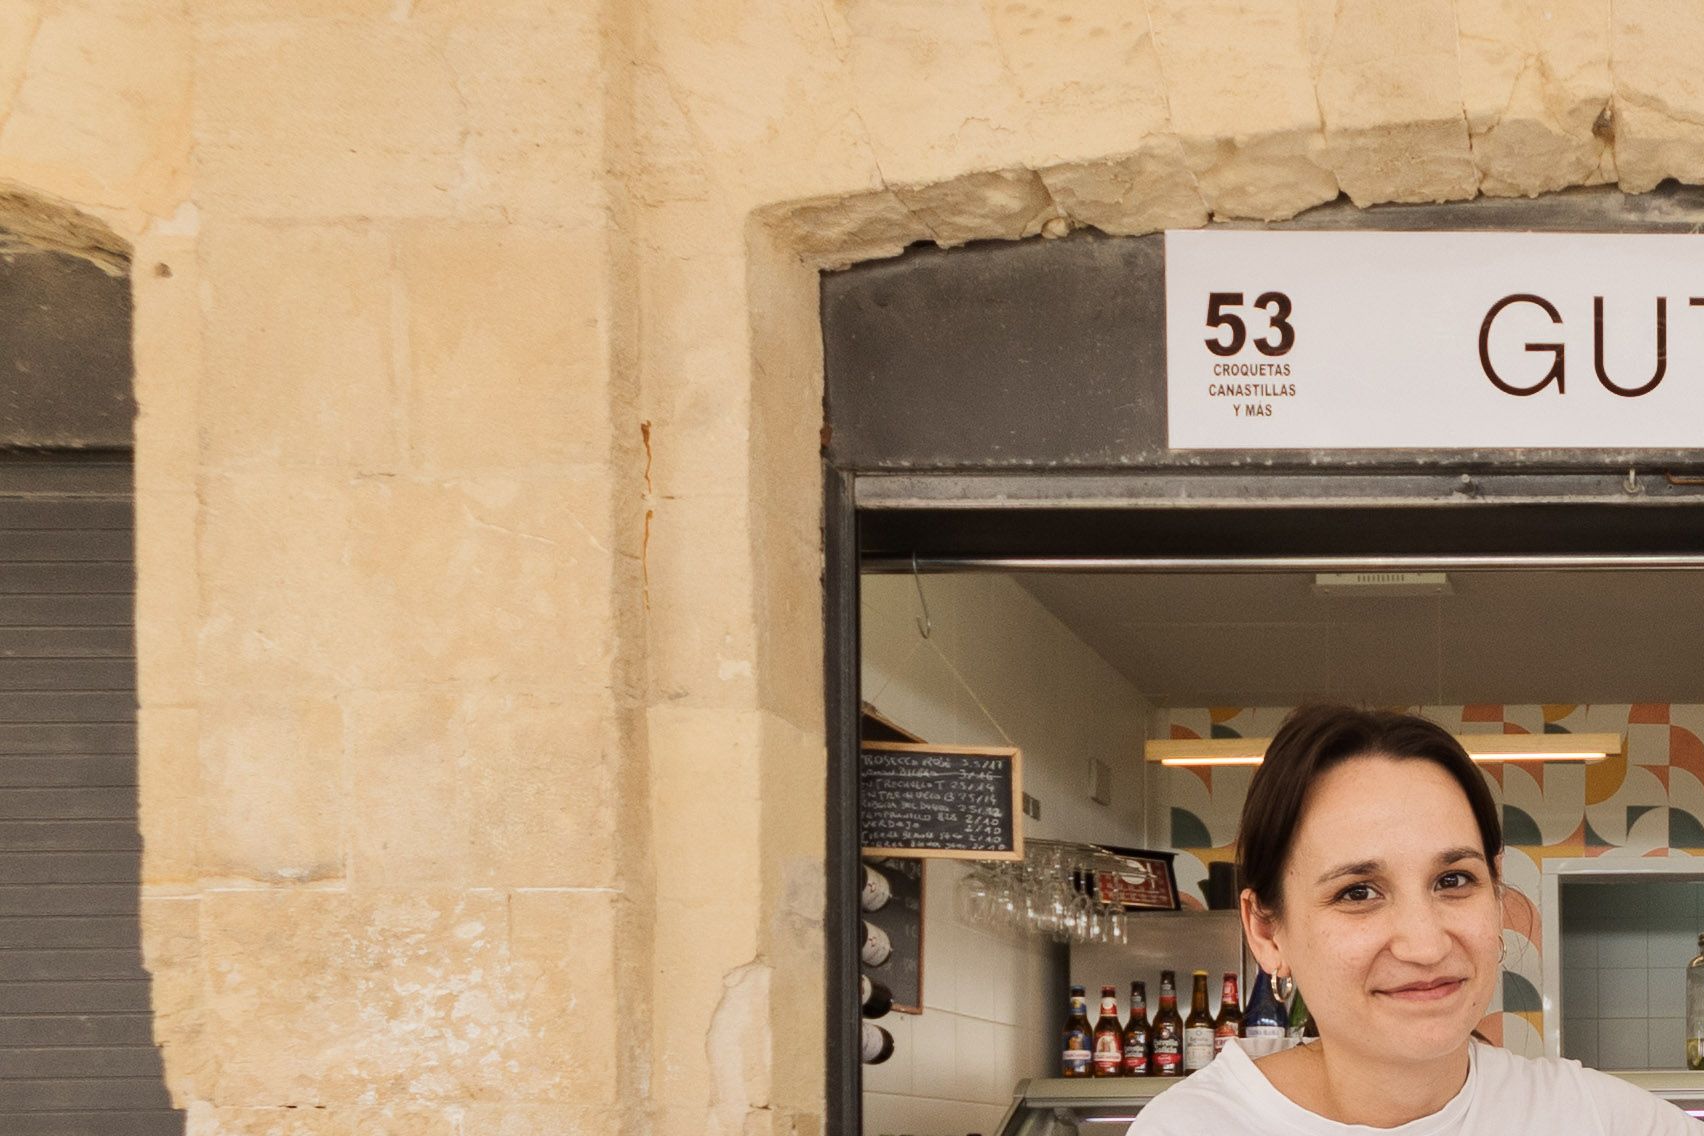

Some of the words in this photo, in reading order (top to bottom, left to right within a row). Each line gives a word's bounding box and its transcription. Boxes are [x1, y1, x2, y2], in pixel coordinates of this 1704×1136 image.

[1204, 291, 1295, 357] 53
[1213, 363, 1291, 377] CROQUETAS
[1208, 383, 1297, 397] CANASTILLAS
[1233, 404, 1241, 417] Y
